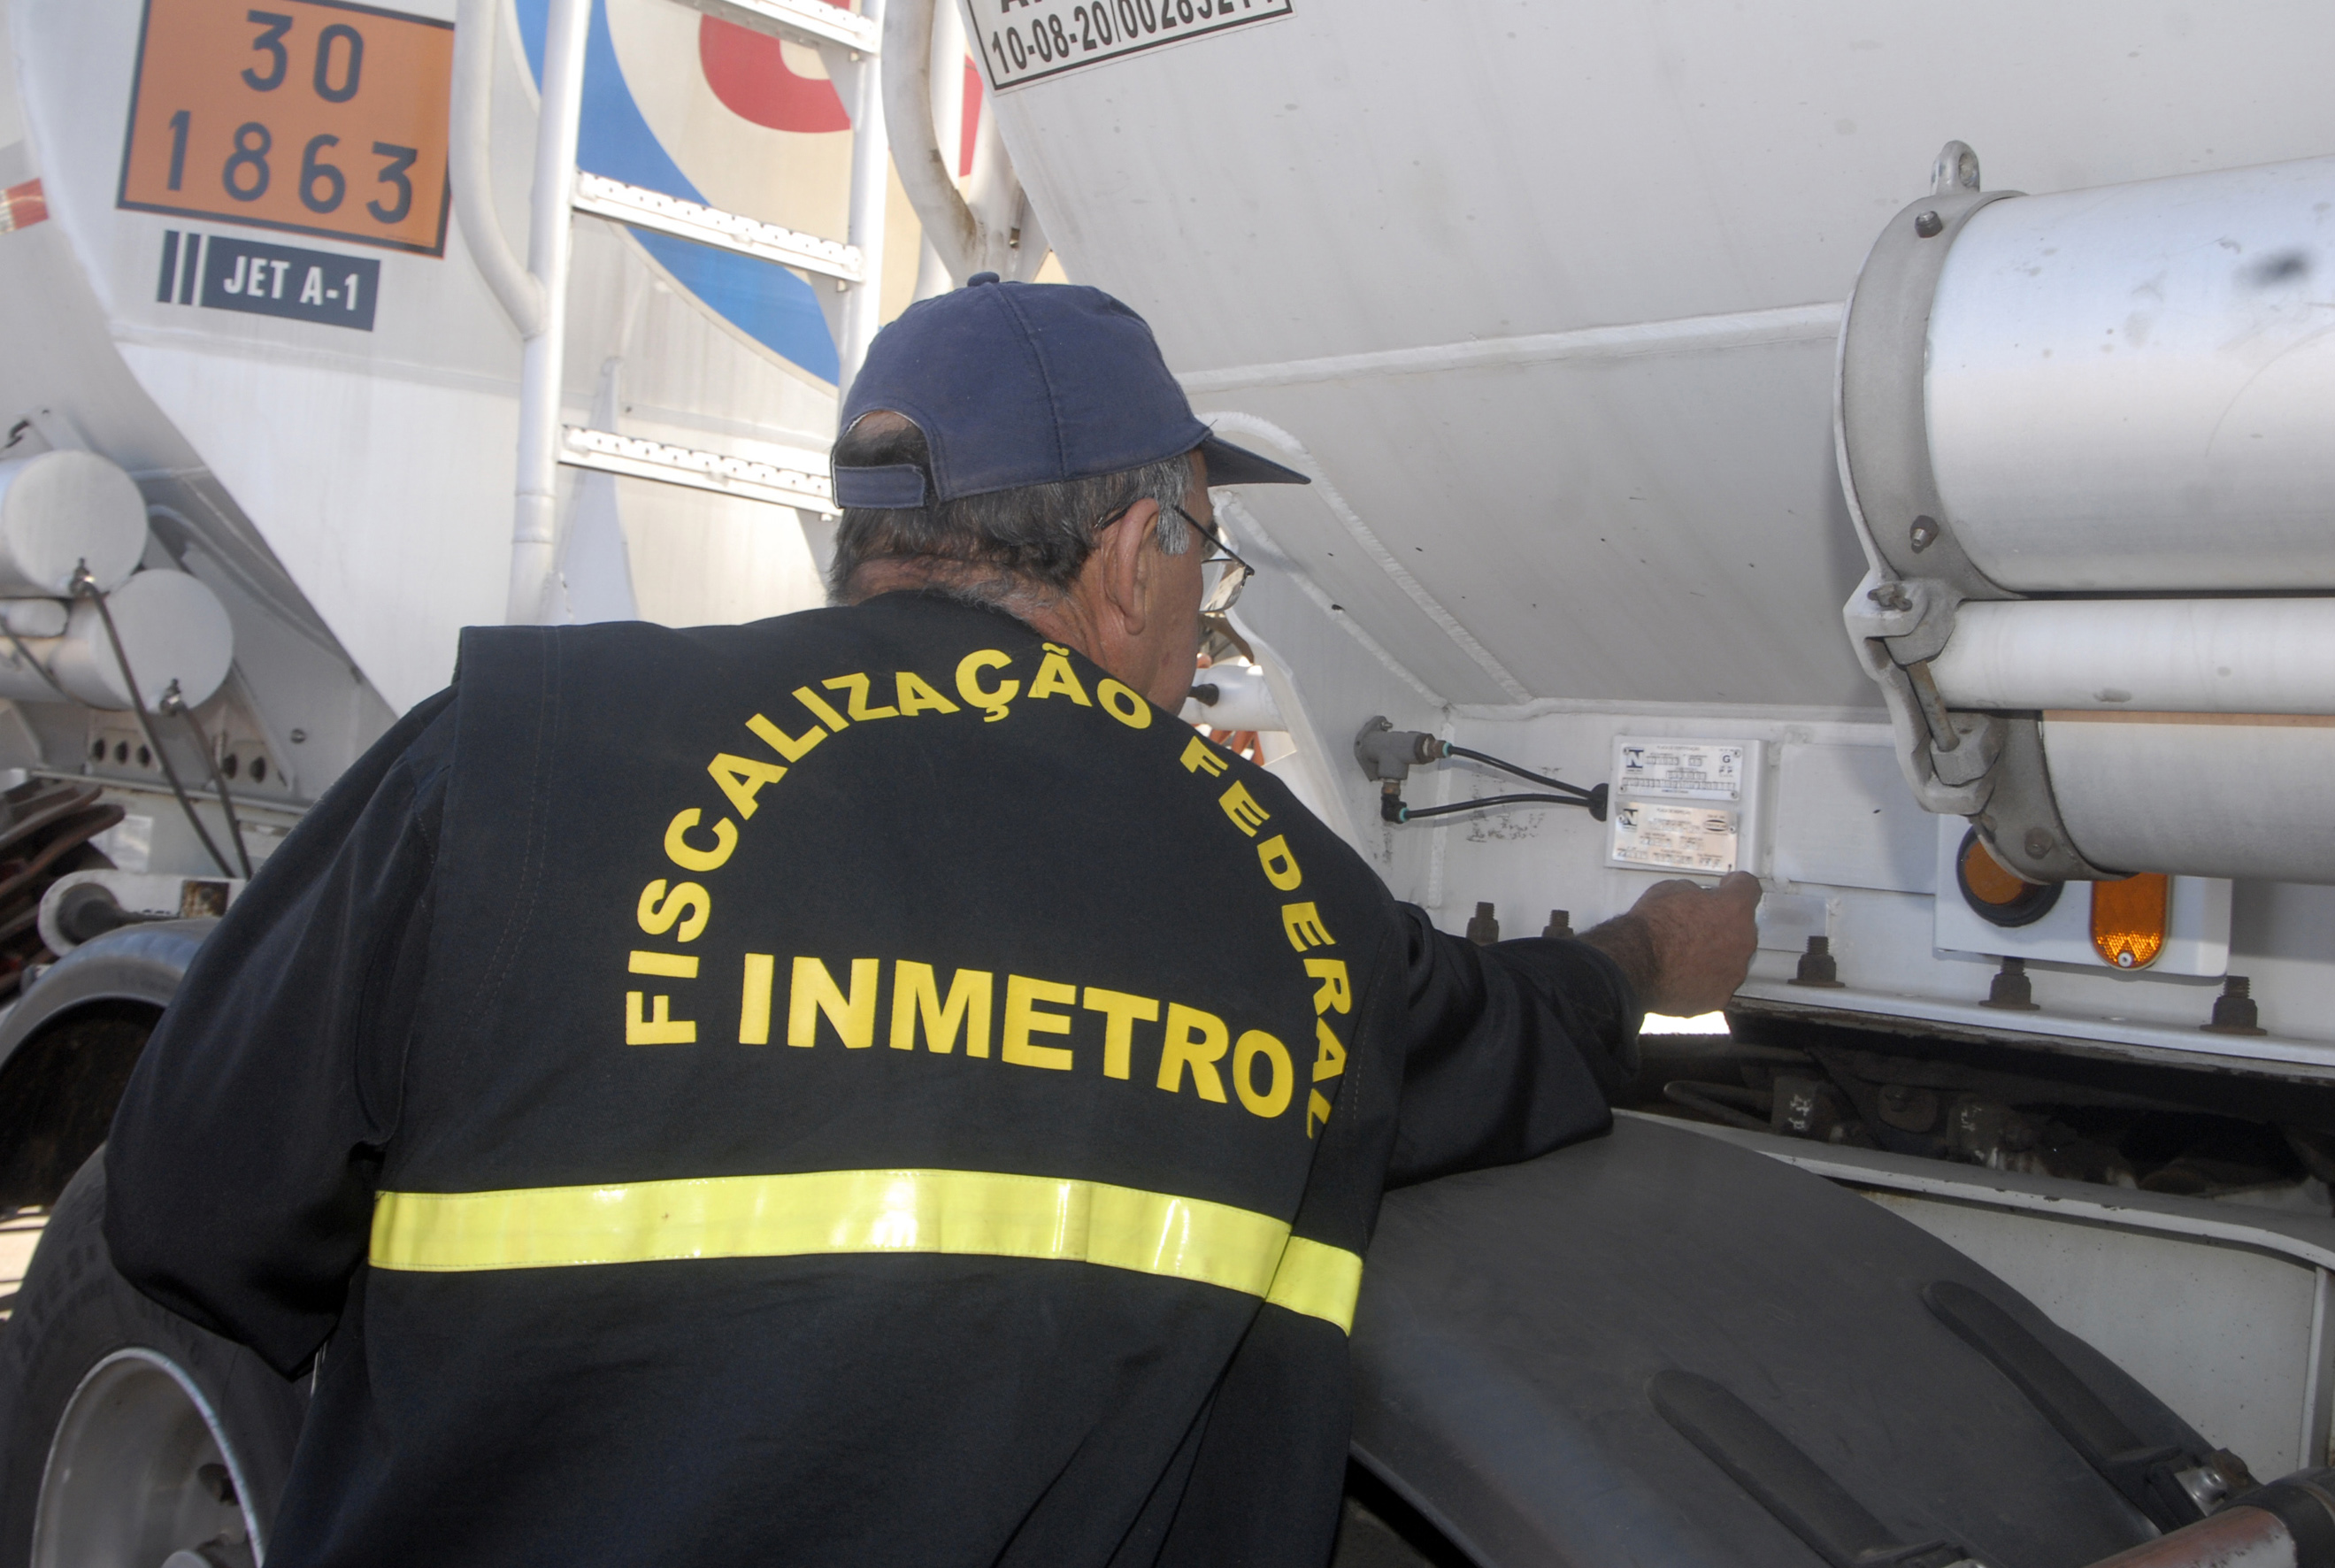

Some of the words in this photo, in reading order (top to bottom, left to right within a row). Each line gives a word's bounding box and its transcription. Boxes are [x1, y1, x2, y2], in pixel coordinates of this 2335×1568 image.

[241, 9, 365, 104] 30
[166, 109, 419, 225] 1863
[224, 256, 290, 299] JET
[299, 265, 358, 311] A-1
[626, 642, 1152, 1045] FISCALIZAÇÃO
[1180, 736, 1351, 1139] FEDERAL
[739, 953, 1294, 1118] INMETRO
